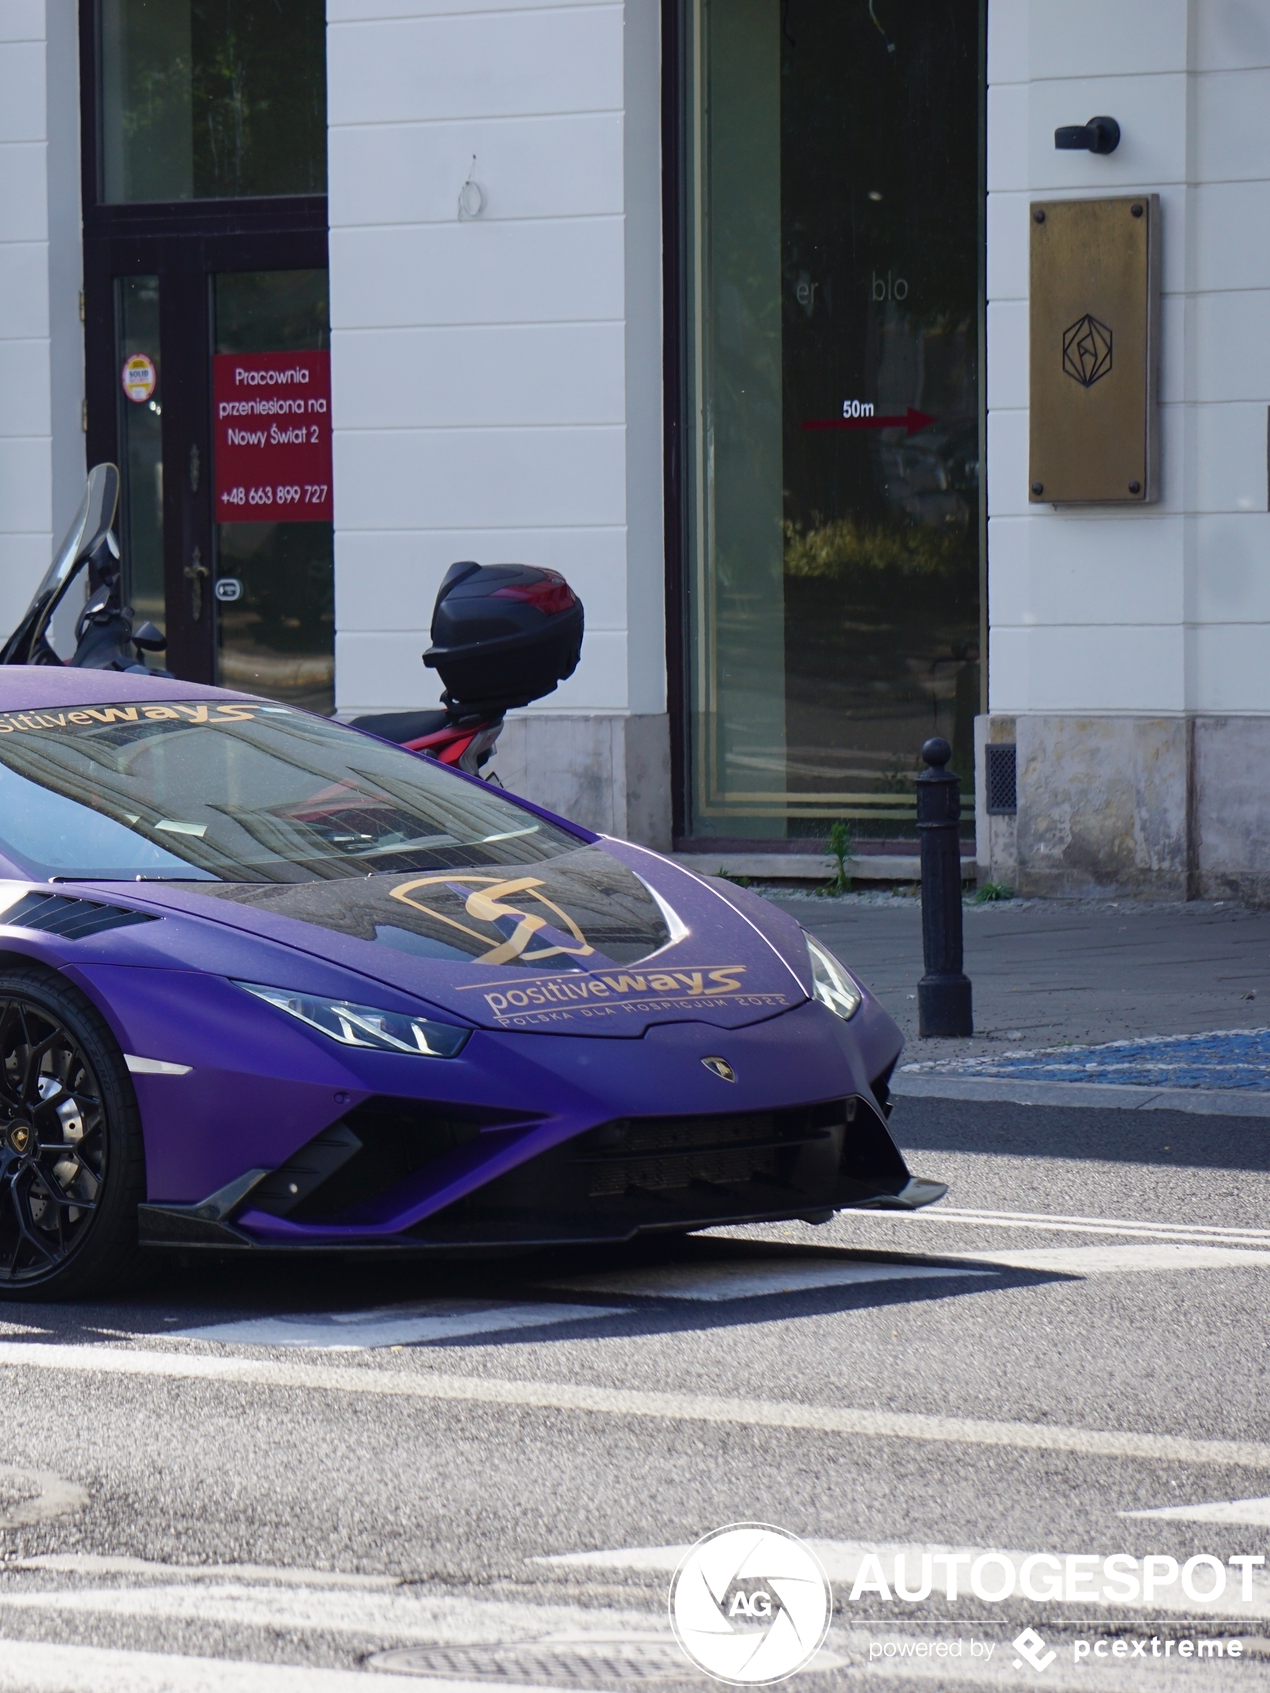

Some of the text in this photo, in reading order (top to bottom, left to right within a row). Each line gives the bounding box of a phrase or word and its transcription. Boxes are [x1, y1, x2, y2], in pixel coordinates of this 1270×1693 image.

[129, 370, 149, 378] SOLID
[235, 366, 310, 386] Pracownia
[219, 397, 327, 419] przeniesiona na
[843, 400, 875, 418] 50m
[228, 423, 319, 448] Nowy Świat 2
[221, 485, 328, 505] +48 663 899 727
[498, 1012, 574, 1028] POLSKA
[583, 1007, 616, 1017] DLA
[737, 996, 790, 1007] 2022
